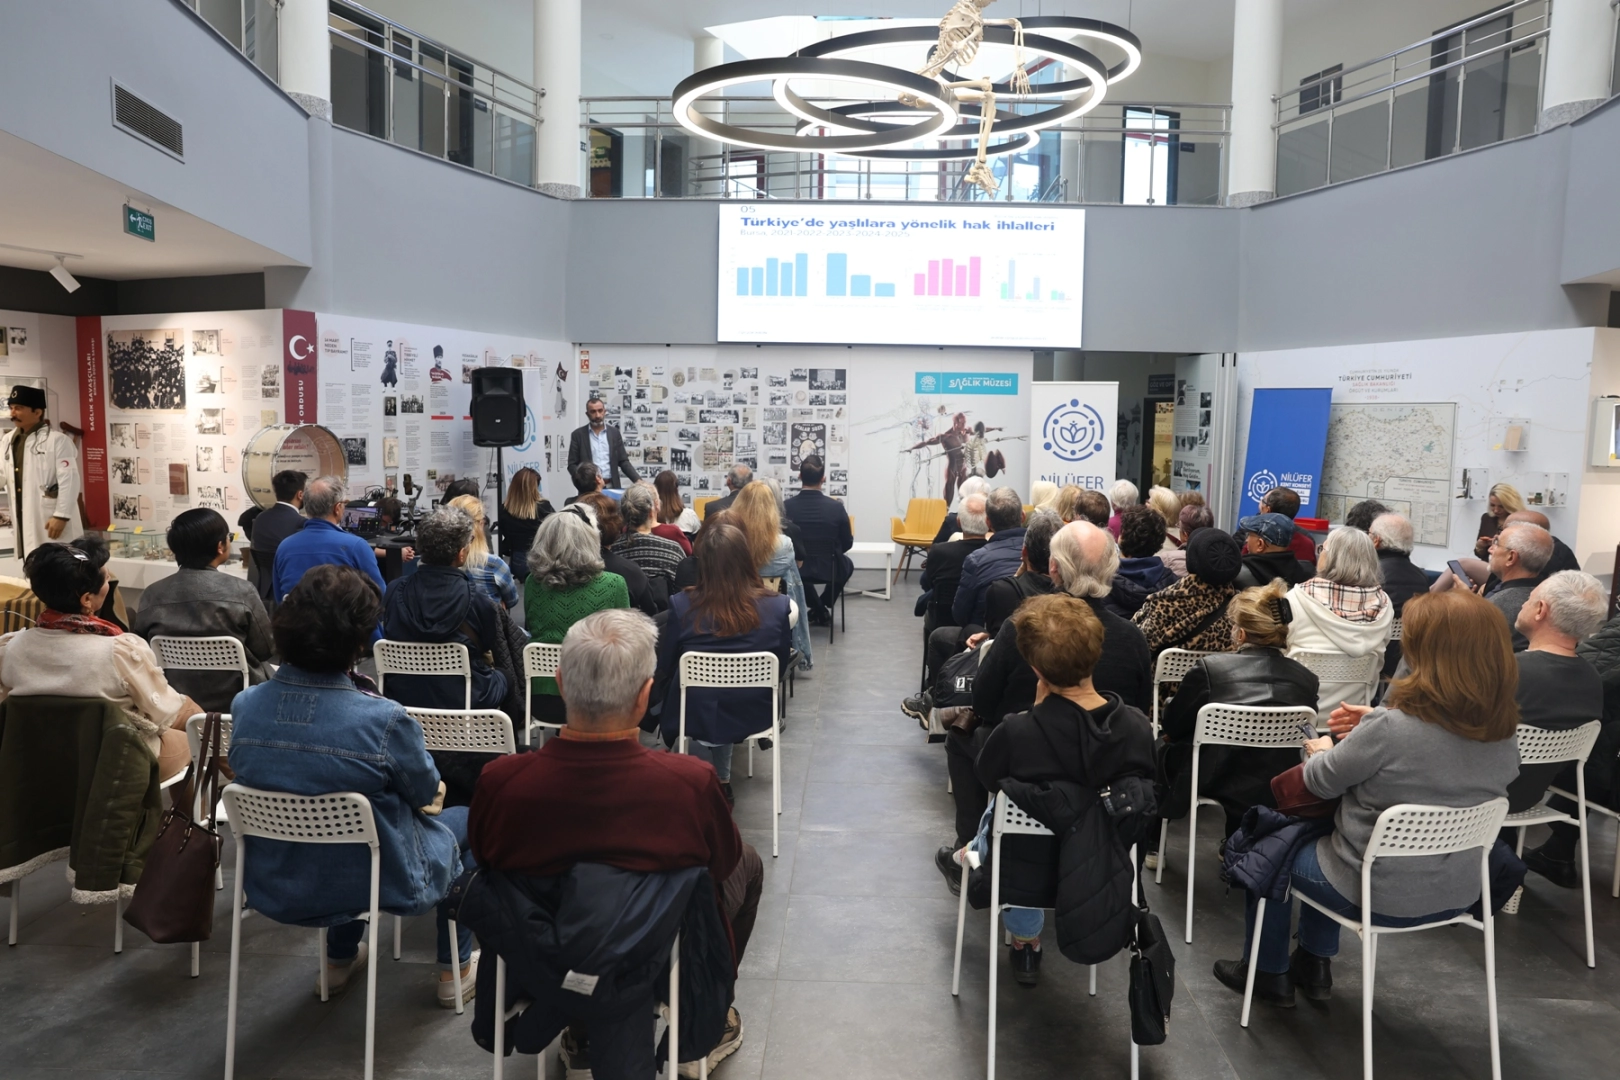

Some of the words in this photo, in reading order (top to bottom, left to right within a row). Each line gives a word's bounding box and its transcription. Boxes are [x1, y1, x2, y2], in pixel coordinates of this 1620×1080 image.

[740, 205, 756, 213] 05
[740, 216, 825, 229] Türkiye'de
[829, 217, 896, 230] yaşlılara
[901, 219, 957, 231] yönelik
[962, 219, 991, 230] hak
[996, 220, 1055, 231] ihlalleri
[770, 229, 910, 238] 2021-2022-2023-2024-2025
[1338, 374, 1365, 382] TÜRKİYE
[1366, 372, 1412, 381] CUMHURİYETİ
[949, 377, 981, 390] SAĞLIK
[983, 378, 1012, 387] MÜZESİ
[1280, 471, 1313, 483] NİLÜFER
